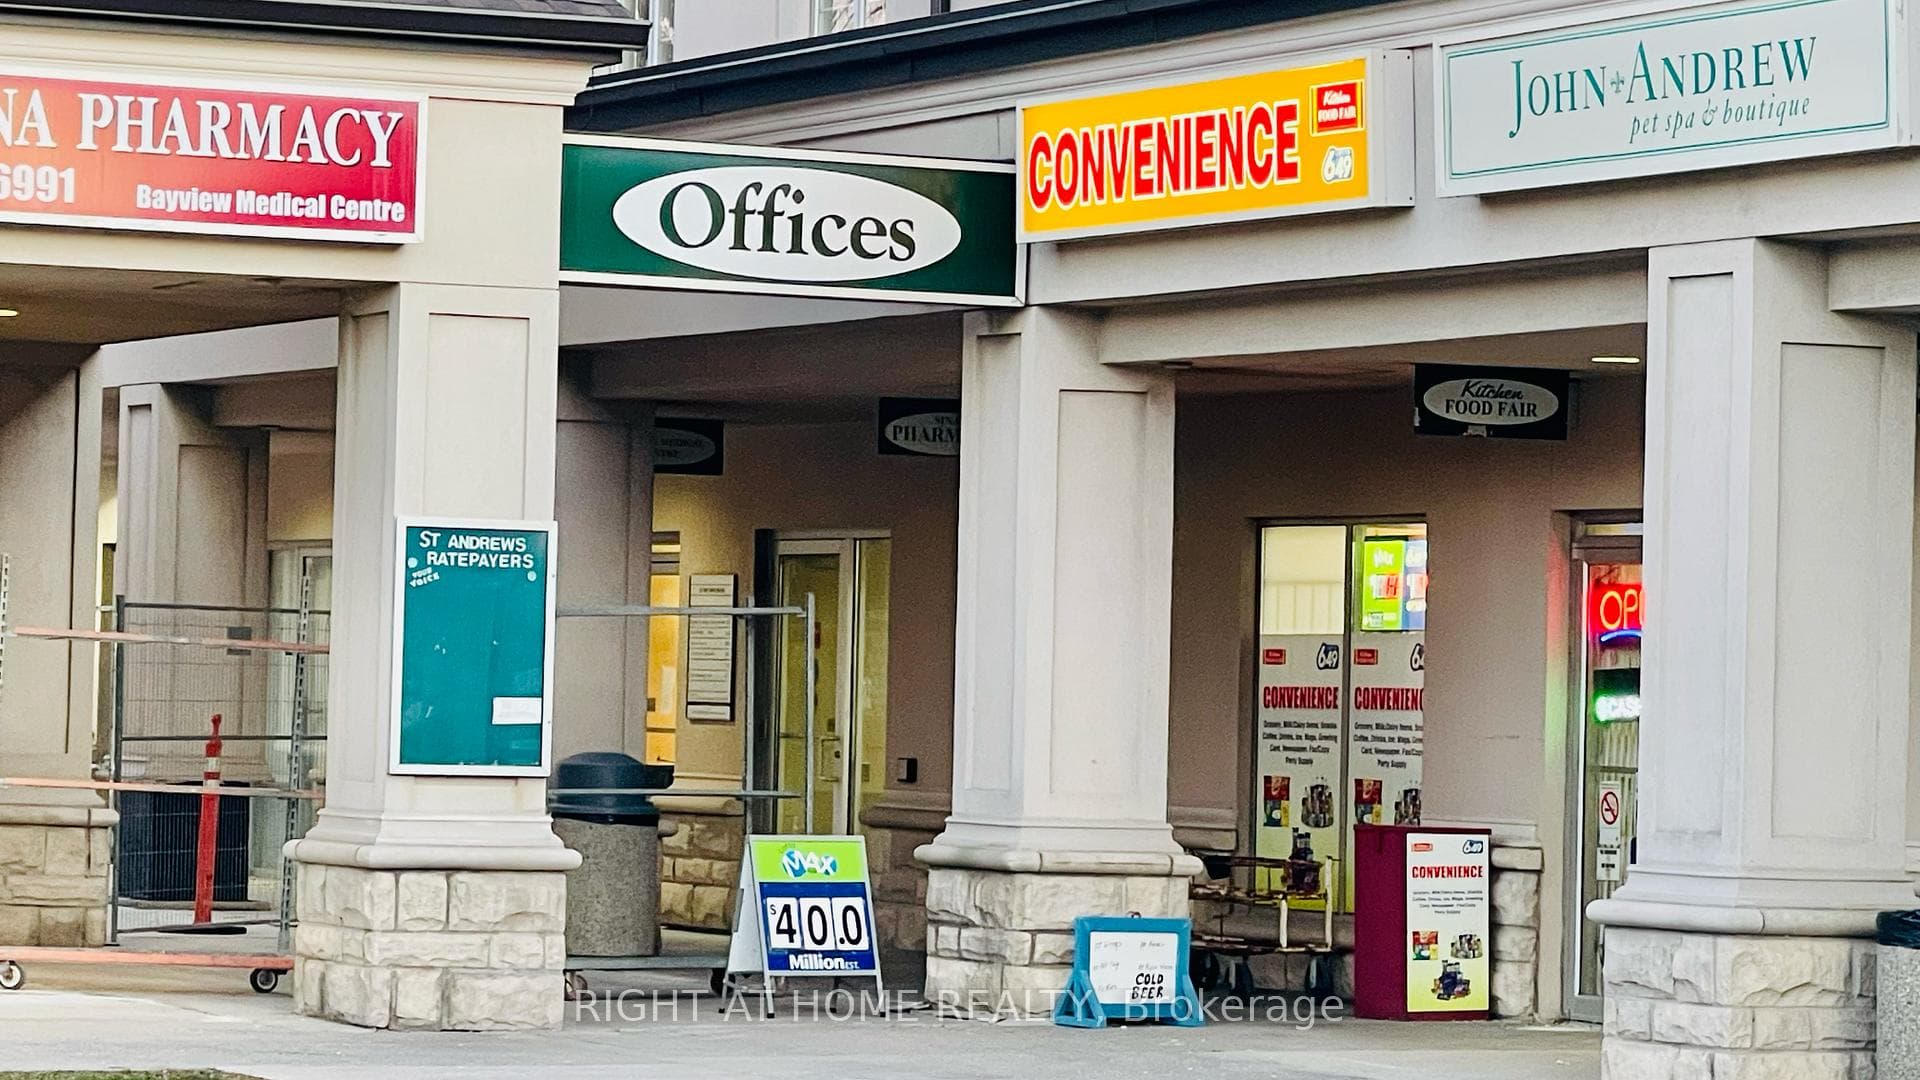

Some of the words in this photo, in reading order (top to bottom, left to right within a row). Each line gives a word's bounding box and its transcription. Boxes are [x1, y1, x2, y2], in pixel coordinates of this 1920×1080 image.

[1509, 60, 1607, 139] JOHN
[1626, 37, 1816, 104] ANDREW
[1629, 115, 1658, 144] pet
[1665, 110, 1694, 139] spa
[1702, 98, 1717, 126] &
[1723, 93, 1810, 126] boutique
[76, 93, 403, 167] PHARMACY
[1029, 102, 1300, 209] CONVENIENCE
[0, 163, 75, 204] 6991
[136, 184, 233, 215] Bayview
[236, 190, 326, 219] Medical
[330, 195, 406, 222] Centre
[660, 181, 917, 261] Offices
[1461, 380, 1523, 400] Kitchen
[1445, 399, 1493, 415] FOOD
[1498, 402, 1537, 418] FAIR
[420, 531, 441, 548] ST
[448, 534, 527, 552] ANDREWS
[426, 551, 534, 569] RATEPAYERS
[1263, 686, 1339, 709] CONVENIENCE
[1412, 865, 1483, 878] CONVENIENCE
[789, 953, 844, 970] Million
[1135, 973, 1164, 985] COLD
[1131, 986, 1164, 999] BEER
